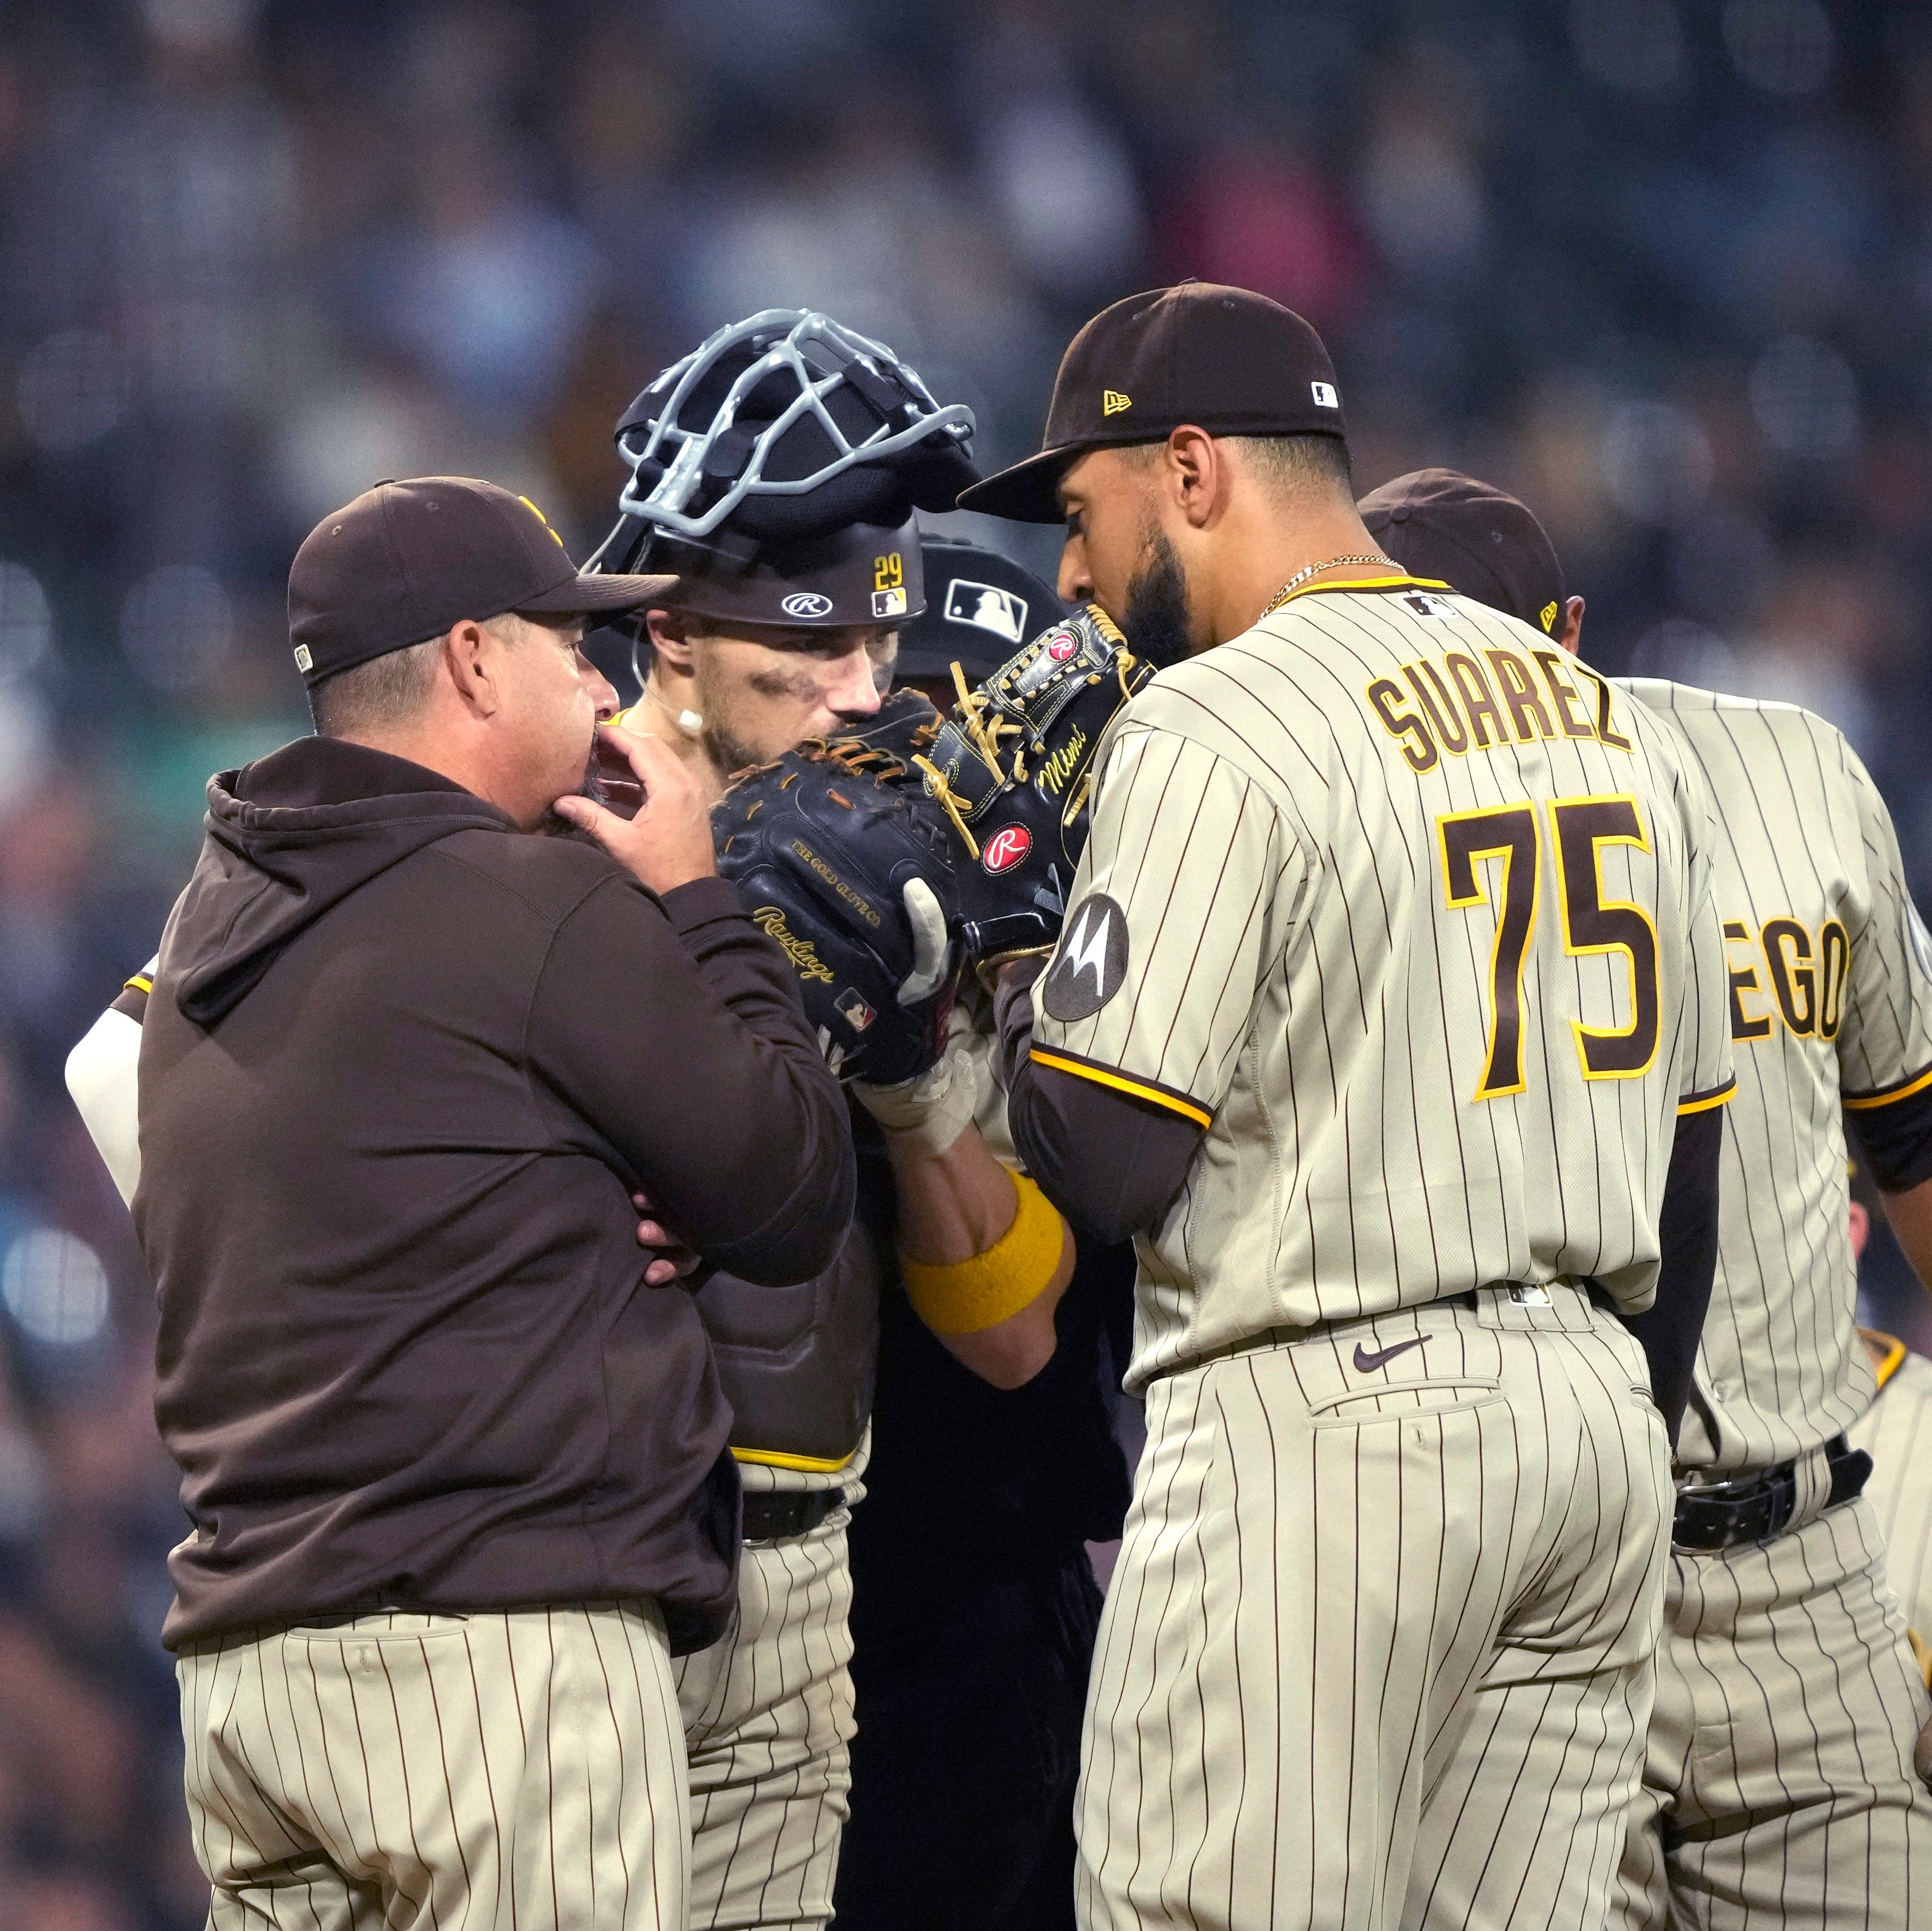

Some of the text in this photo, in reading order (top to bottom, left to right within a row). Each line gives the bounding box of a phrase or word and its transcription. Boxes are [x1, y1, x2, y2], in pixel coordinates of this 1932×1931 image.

[874, 552, 903, 591] 29
[1365, 648, 1635, 774] SUAREZ
[810, 857, 838, 885] GOLD
[836, 882, 869, 915] GLOVE
[753, 906, 835, 984] Rawlings
[1435, 793, 1662, 1102] 75
[1722, 916, 1850, 1042] EGO
